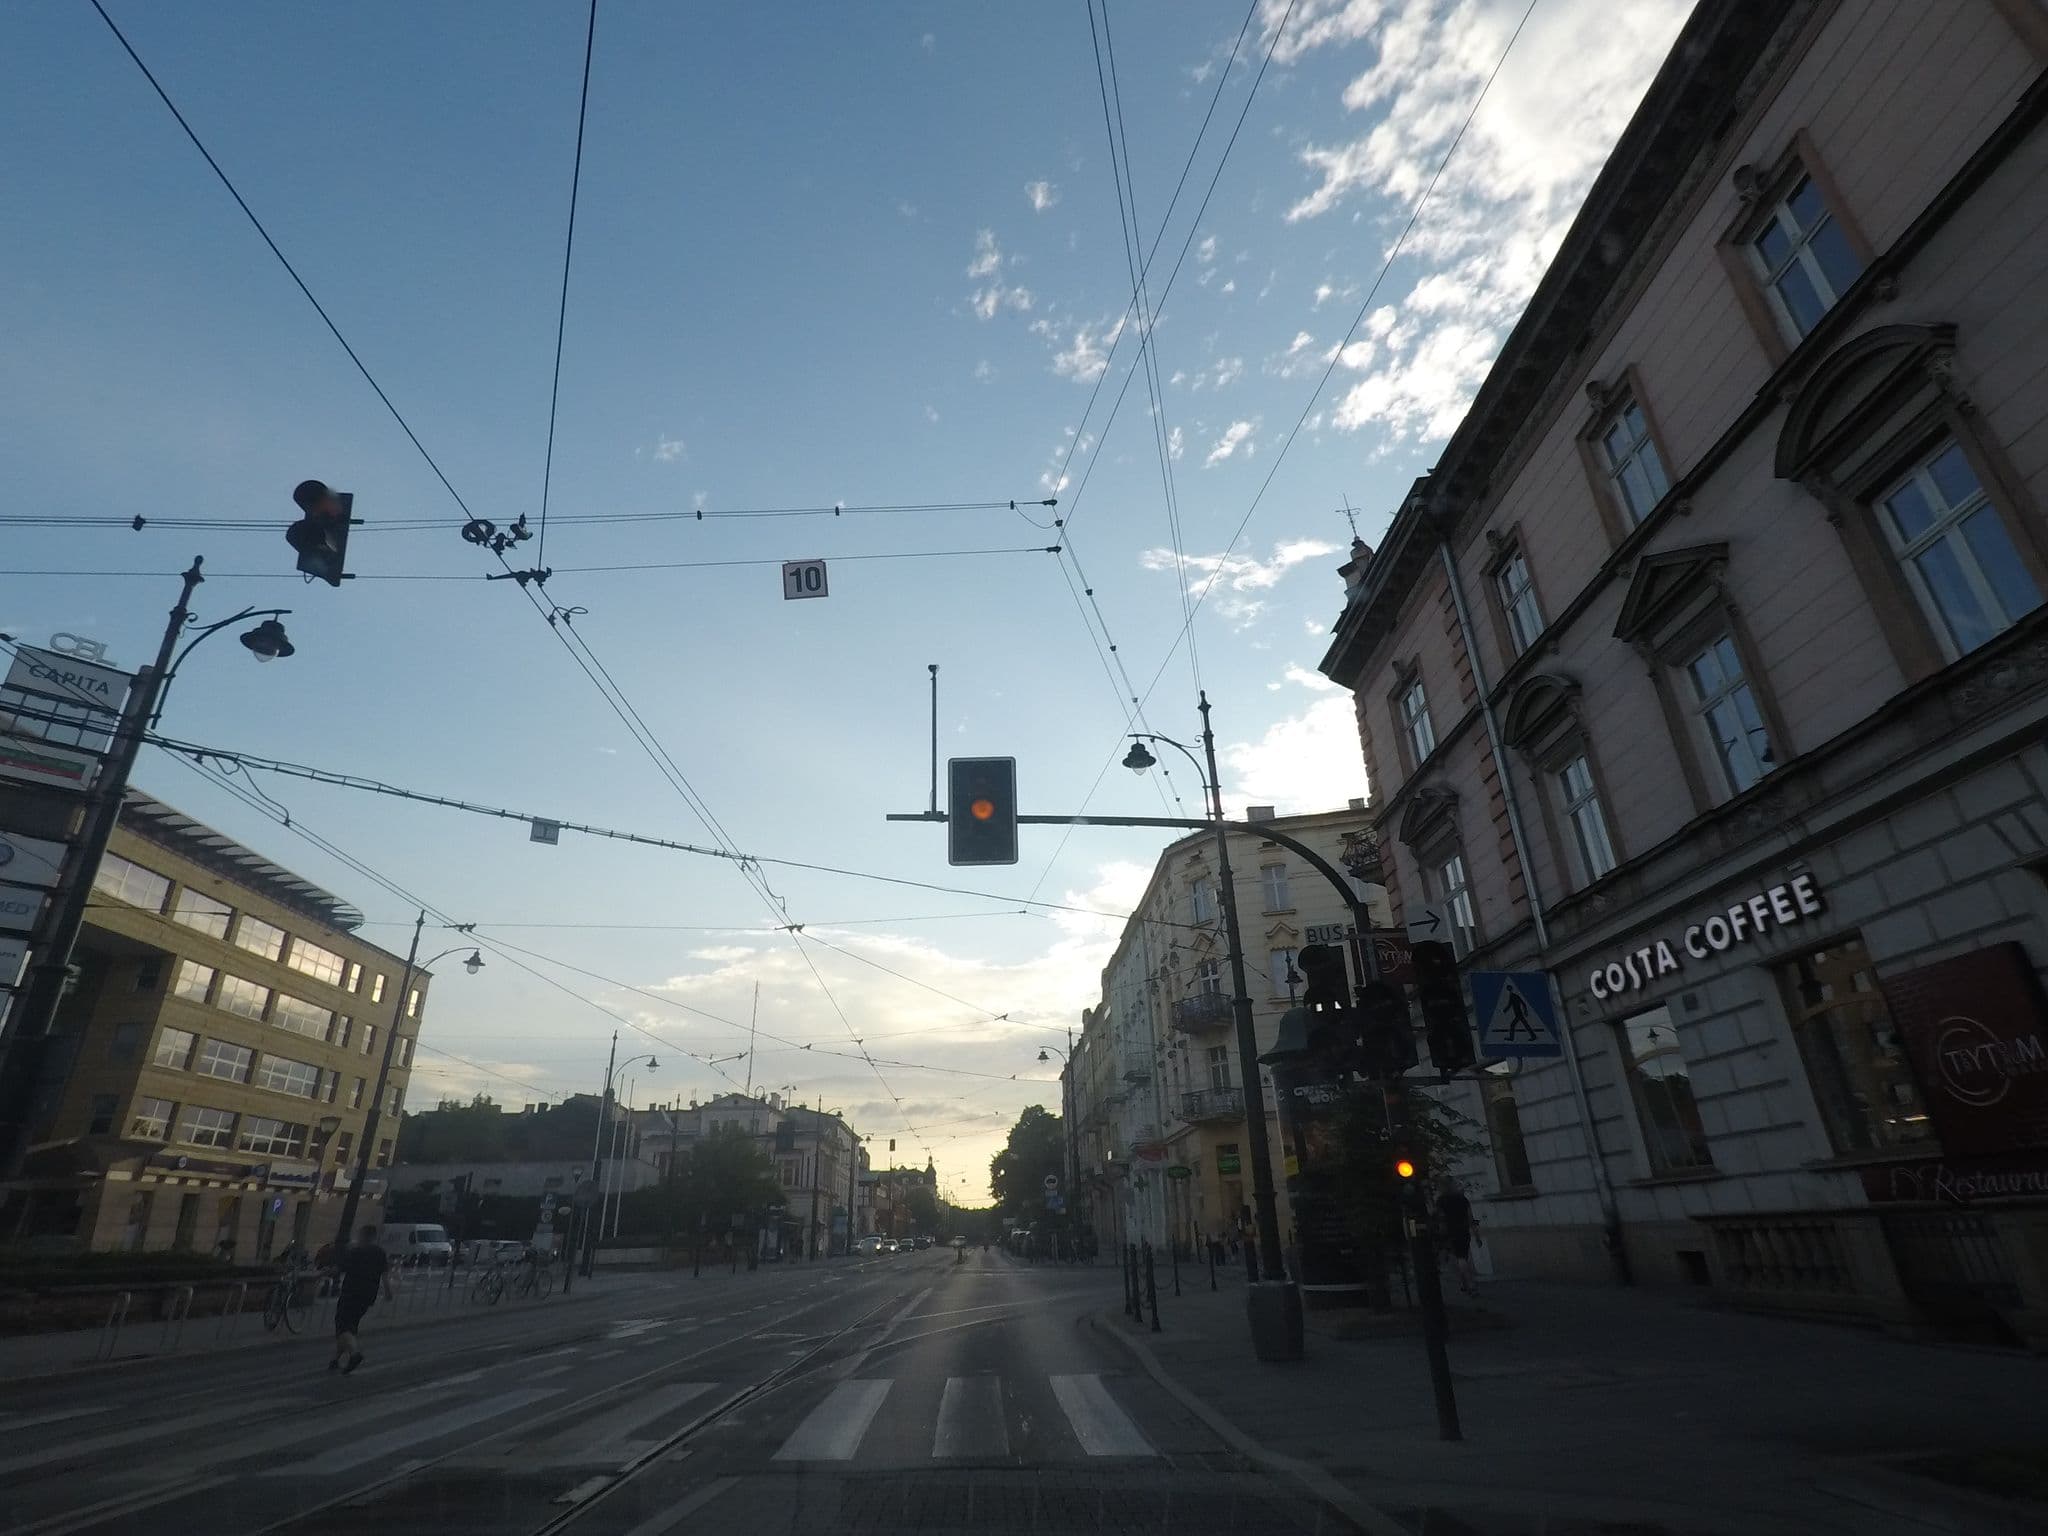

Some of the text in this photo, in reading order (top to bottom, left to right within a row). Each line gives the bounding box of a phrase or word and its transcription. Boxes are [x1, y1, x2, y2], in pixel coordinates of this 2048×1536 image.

[790, 567, 821, 592] 10
[1306, 926, 1342, 943] BUS
[1590, 875, 1820, 999] COSTA COFFEE
